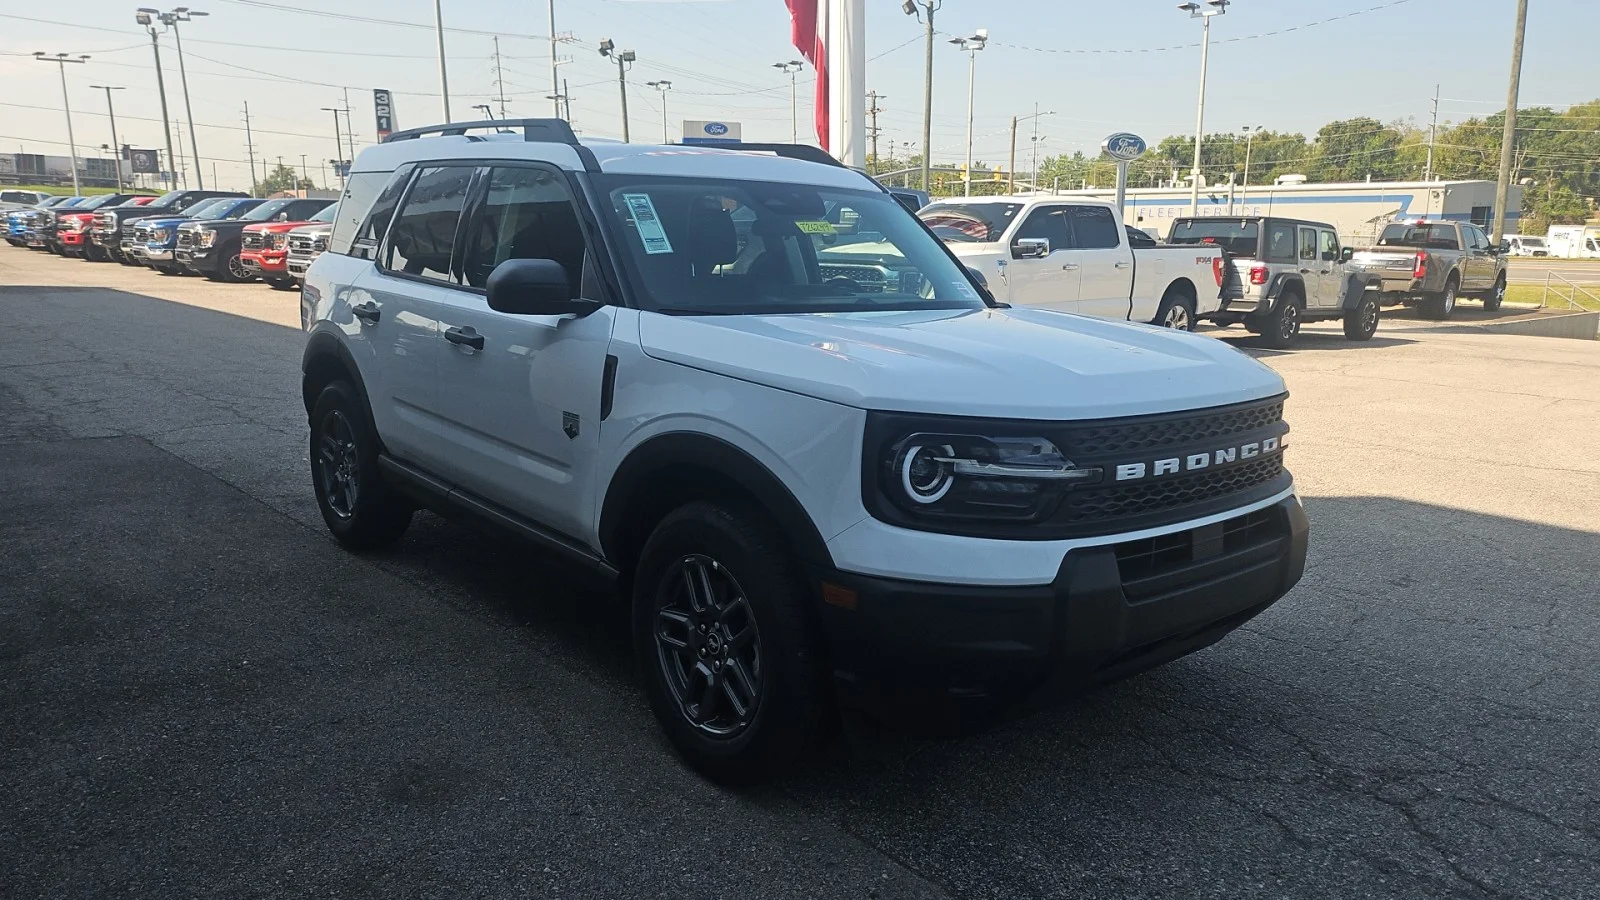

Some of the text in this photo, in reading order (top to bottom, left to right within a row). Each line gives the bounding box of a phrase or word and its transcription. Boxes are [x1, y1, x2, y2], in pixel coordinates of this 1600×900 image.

[1116, 138, 1140, 156] Ford
[1140, 207, 1184, 218] FLEET
[1115, 437, 1278, 481] BRONCO
